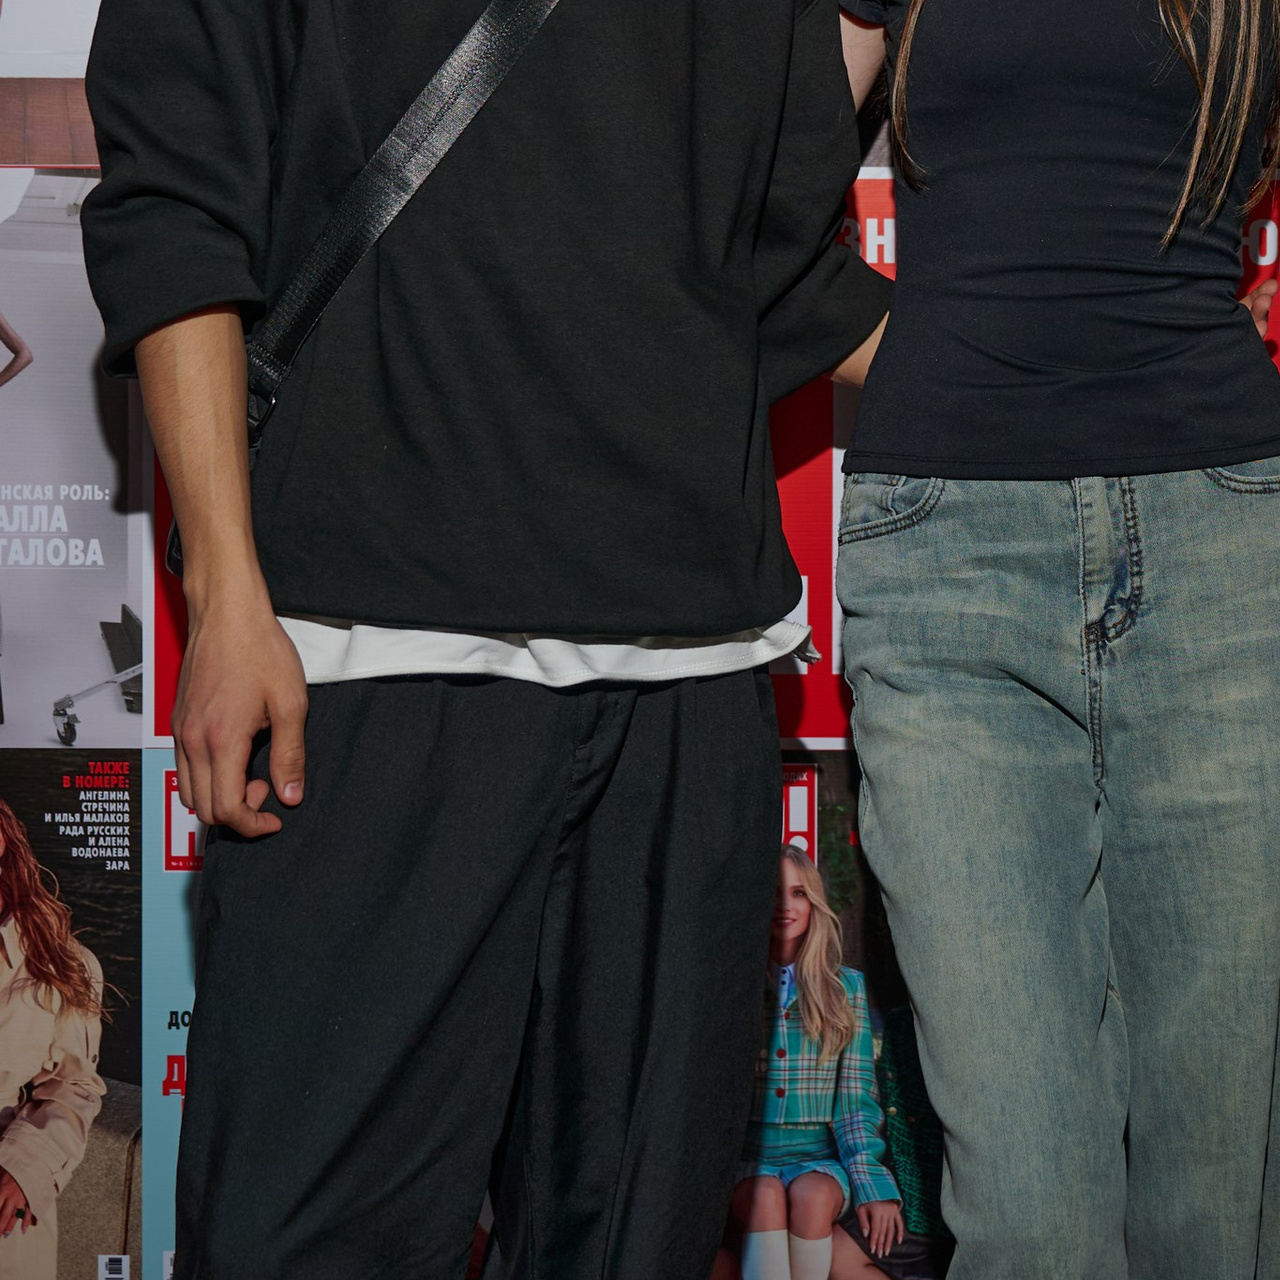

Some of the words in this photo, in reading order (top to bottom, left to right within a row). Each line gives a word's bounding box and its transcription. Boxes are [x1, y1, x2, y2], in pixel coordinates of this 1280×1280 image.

[60, 484, 110, 501] РОЛЬ:
[79, 791, 130, 801] АНГЕЛИНА
[81, 802, 130, 812] СТРЕЧИНА
[55, 813, 80, 823] ИЛЬЯ
[83, 813, 130, 823] МАЛАКОВ
[59, 826, 84, 836] РАДА
[87, 826, 130, 835] РУССКИХ
[98, 837, 130, 846] АЛЕНА
[71, 848, 130, 858] ВОДОНАЕВА
[105, 861, 130, 870] ЗАРА
